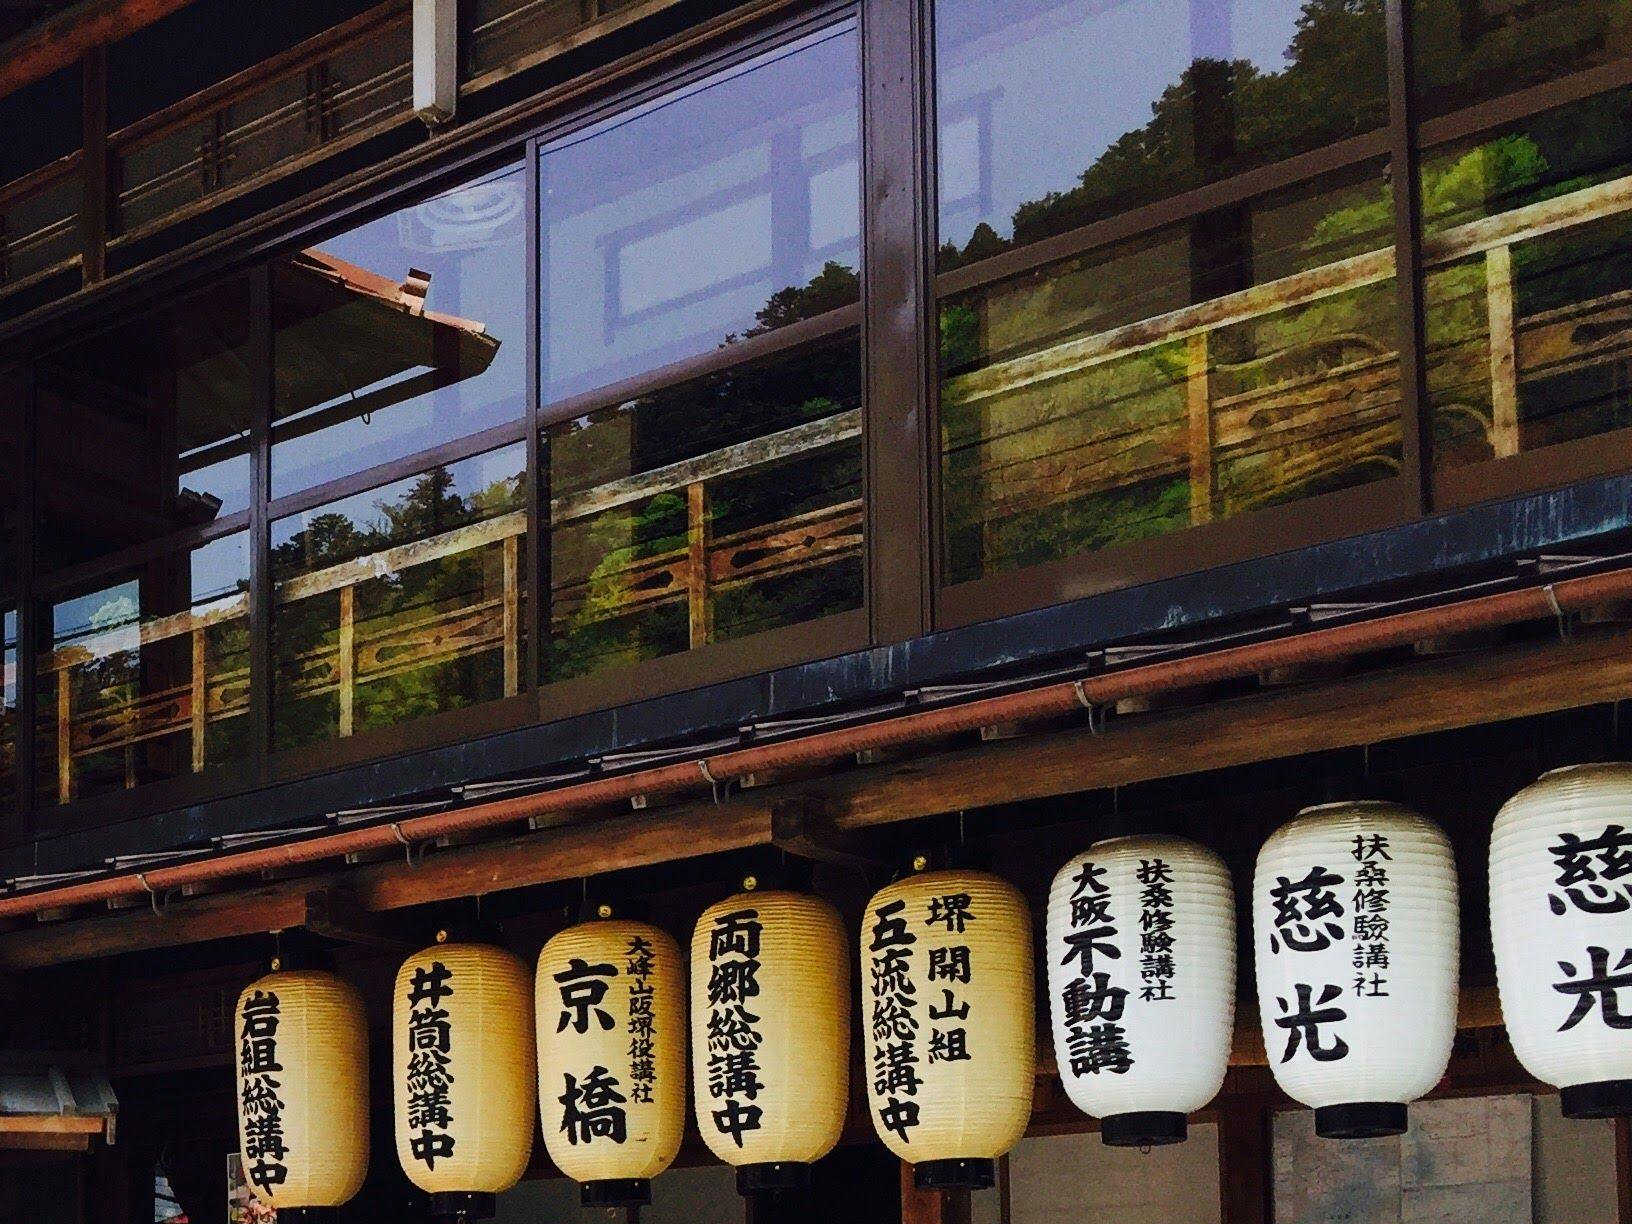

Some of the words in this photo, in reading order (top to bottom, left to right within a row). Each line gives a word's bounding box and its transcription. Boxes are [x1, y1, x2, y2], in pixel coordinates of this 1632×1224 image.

[407, 961, 456, 1171] 井筒総講中
[553, 959, 629, 1147] 京橋
[1059, 862, 1136, 1080] 大阪不動講
[1269, 866, 1350, 1064] 慈光
